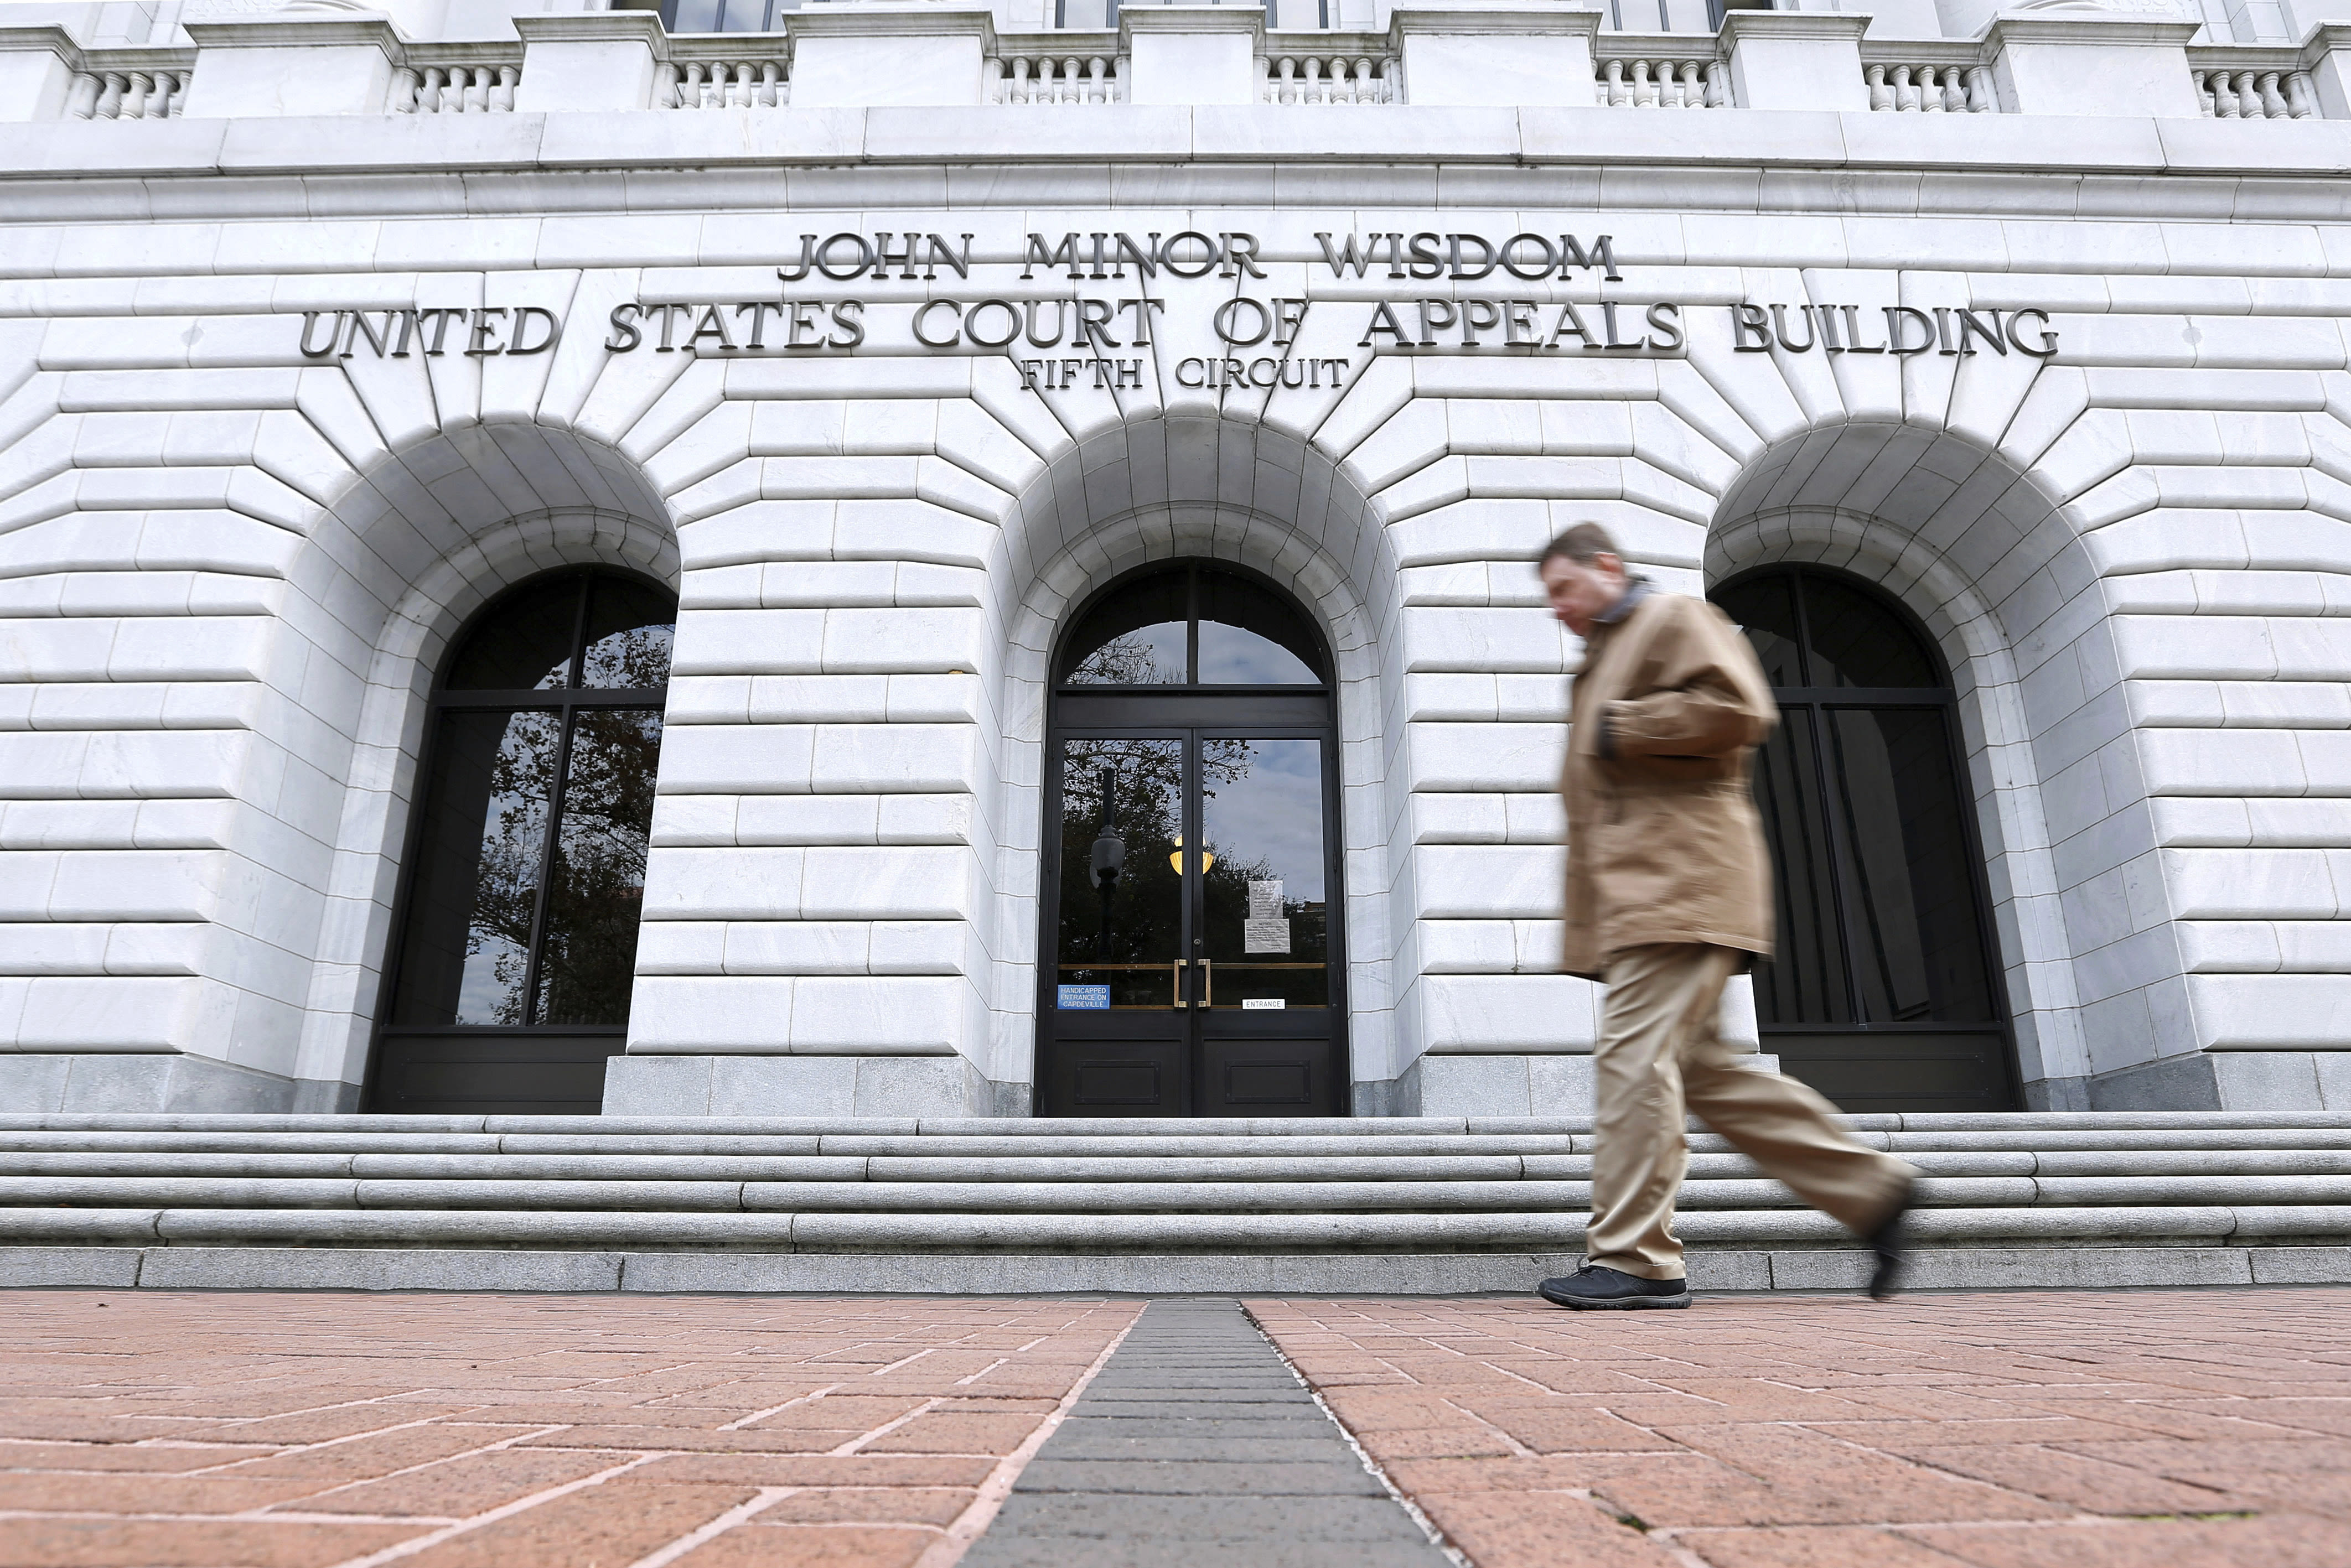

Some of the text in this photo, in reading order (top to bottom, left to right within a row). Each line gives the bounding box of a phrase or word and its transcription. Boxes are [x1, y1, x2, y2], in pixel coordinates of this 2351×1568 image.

[777, 231, 1623, 282] JOHN MINOR WISDOM
[299, 298, 2059, 358] UNITED STATES COURT OF APPEALS BUILDING
[1021, 358, 1349, 390] FIFTH CIRCUIT
